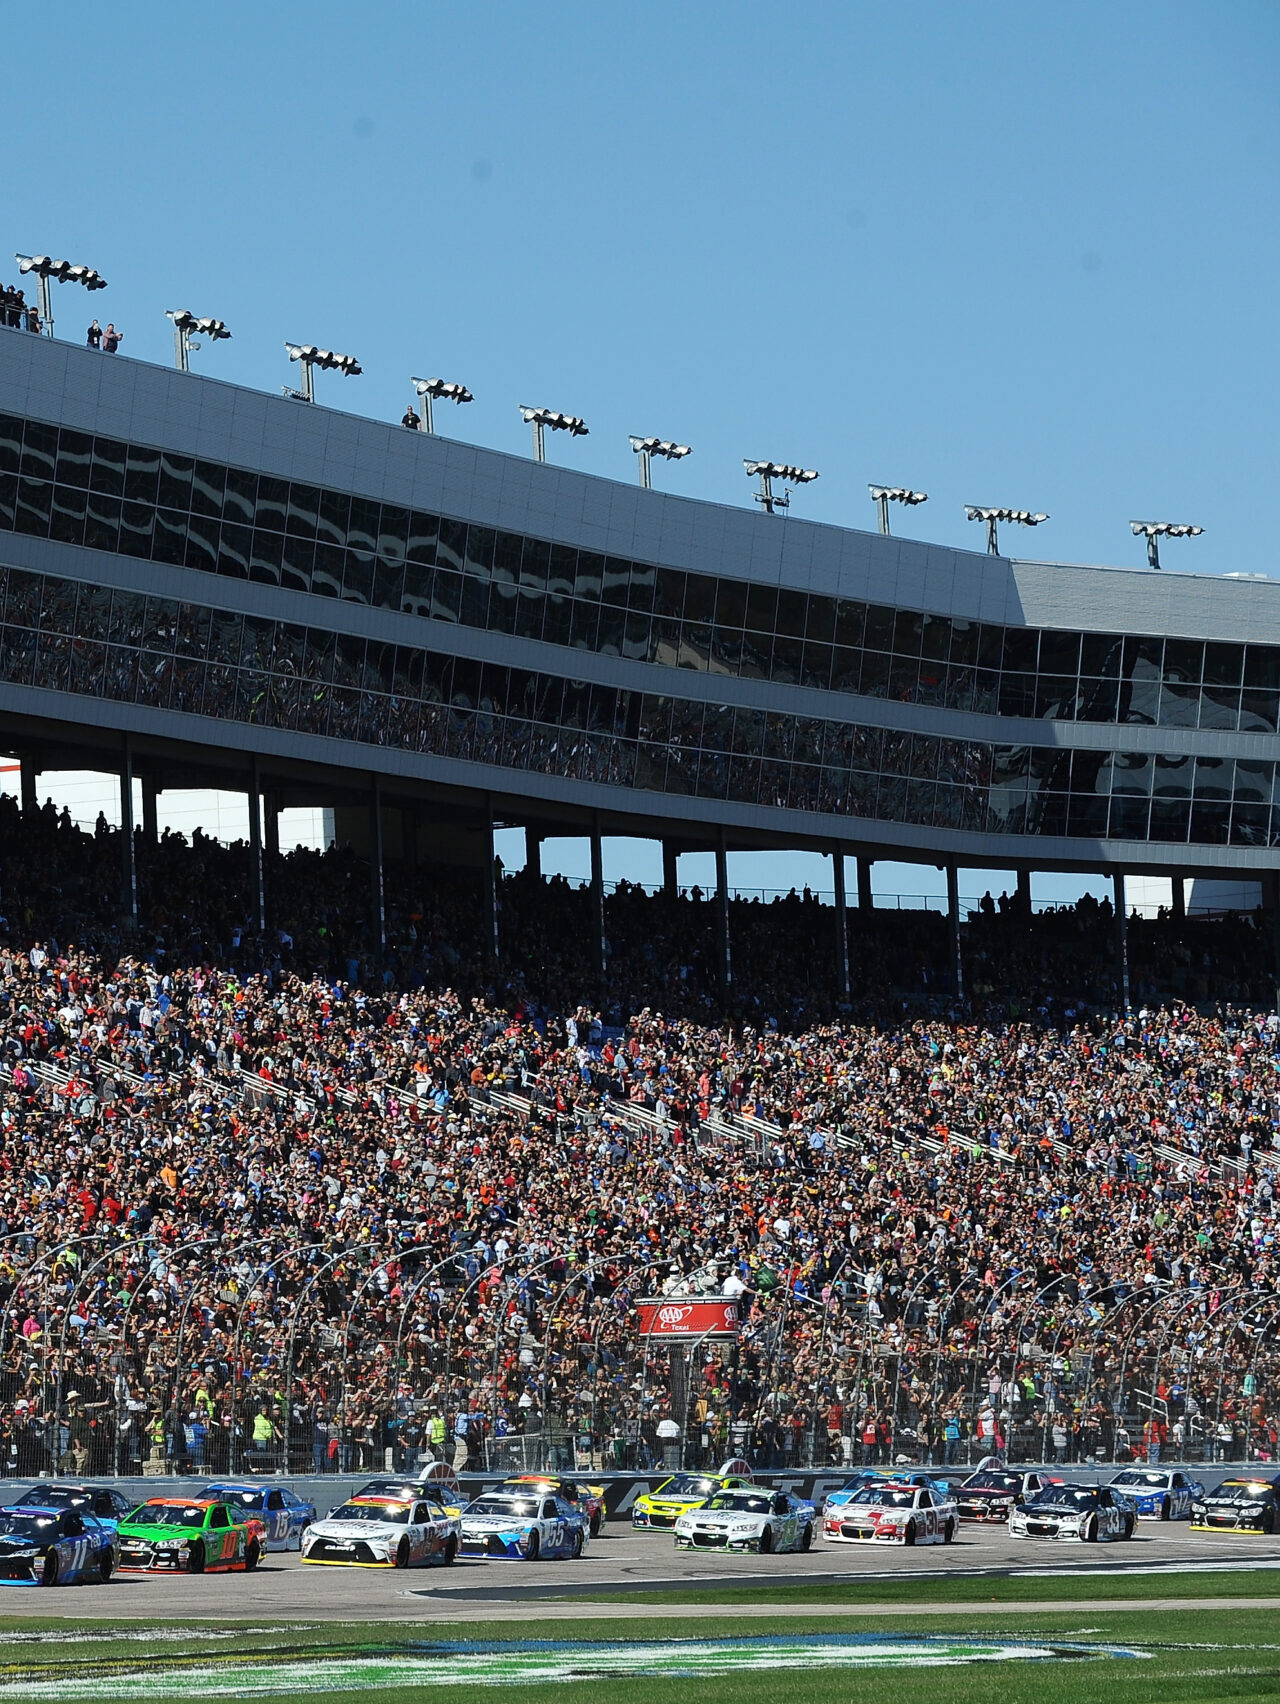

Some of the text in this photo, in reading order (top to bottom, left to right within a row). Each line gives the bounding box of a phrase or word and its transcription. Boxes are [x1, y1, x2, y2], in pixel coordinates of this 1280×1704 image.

[660, 1307, 681, 1322] AAA
[671, 1323, 690, 1331] Texas
[274, 1511, 290, 1539] 15
[547, 1520, 565, 1548] 55
[1105, 1506, 1120, 1534] 33
[71, 1539, 88, 1570] 11
[220, 1531, 238, 1560] 10
